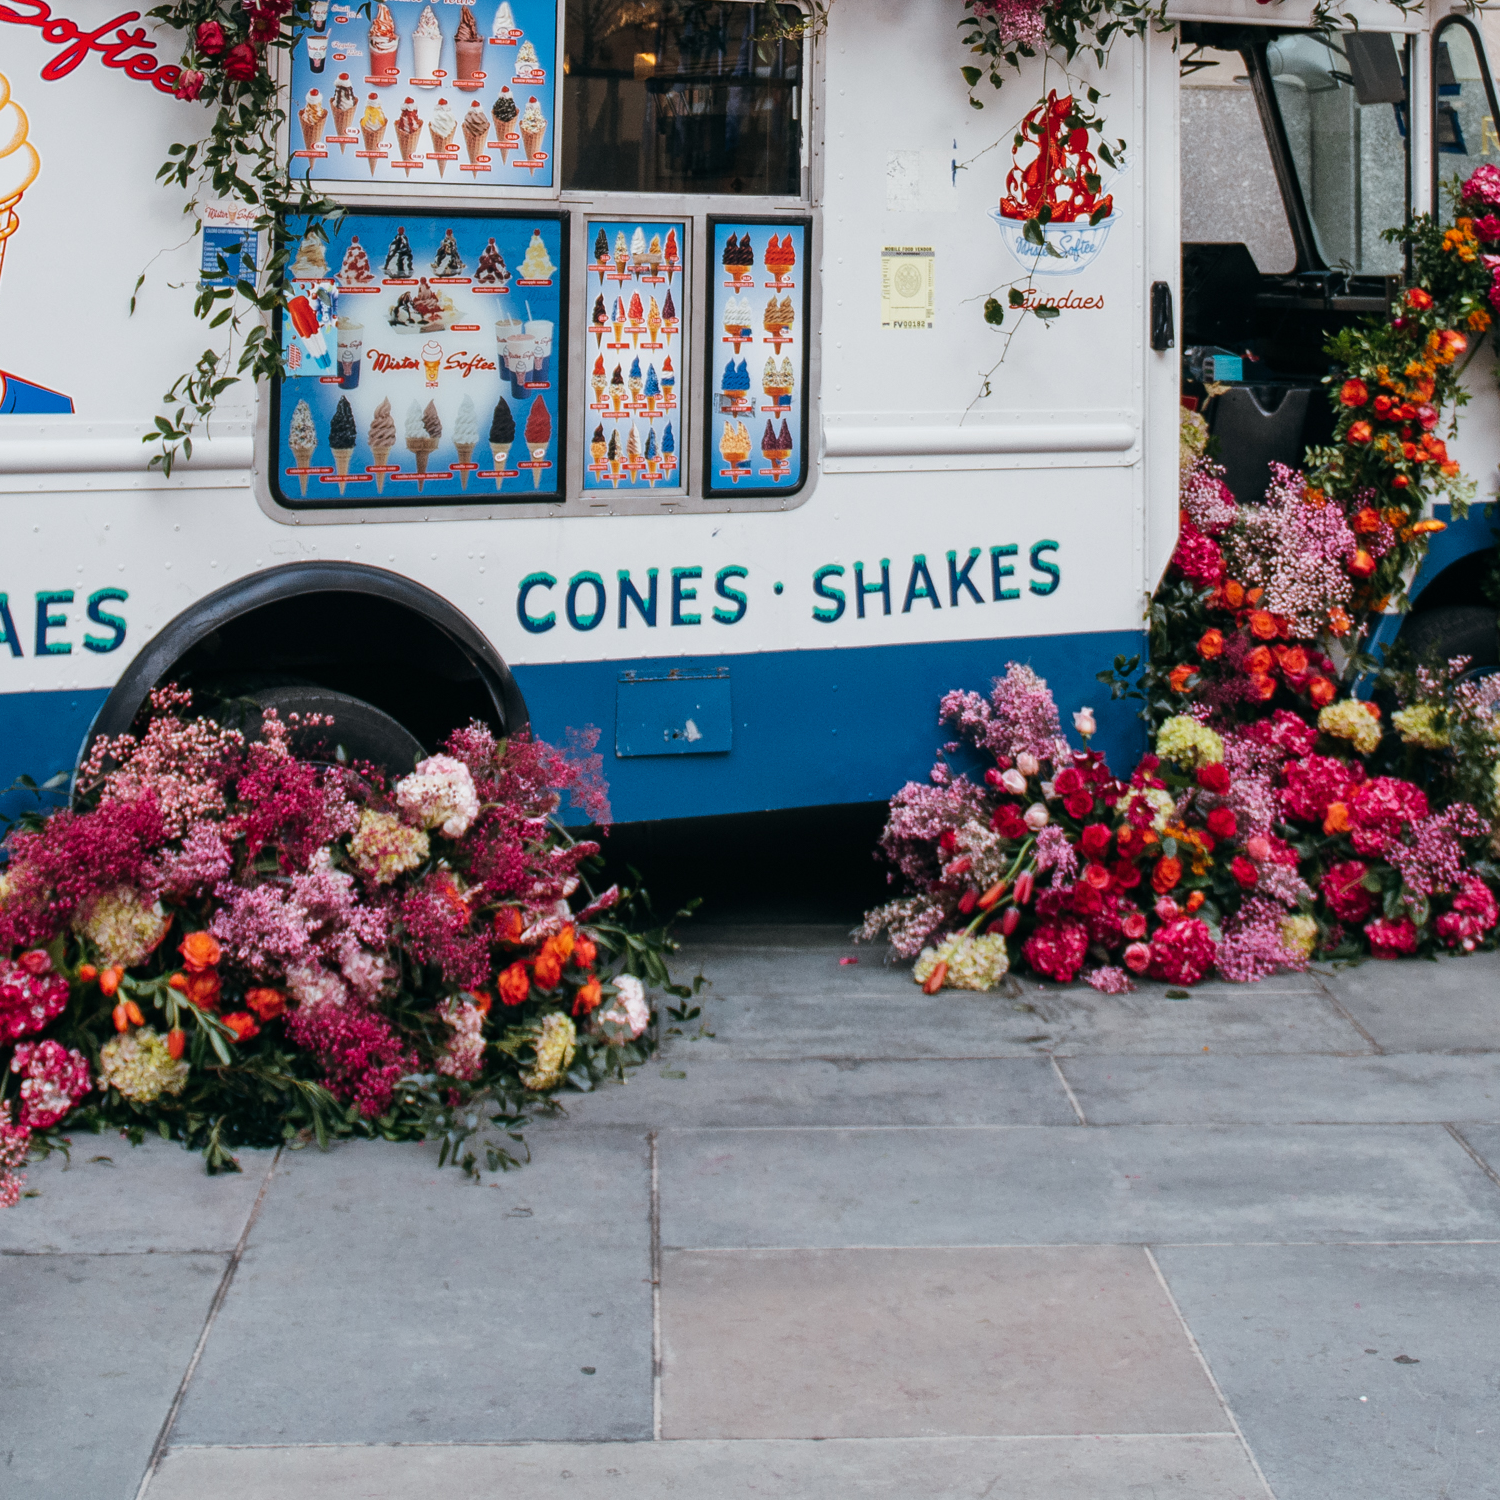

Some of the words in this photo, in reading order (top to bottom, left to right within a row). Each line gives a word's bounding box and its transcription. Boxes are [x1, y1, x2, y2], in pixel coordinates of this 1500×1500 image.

[204, 204, 229, 220] Mister
[1015, 236, 1052, 258] Miste
[1059, 234, 1097, 262] Softee
[893, 320, 926, 329] FV00182
[367, 348, 420, 373] Mister
[443, 351, 497, 378] Softee
[516, 564, 749, 635] CONES
[812, 539, 1061, 624] SHAKES
